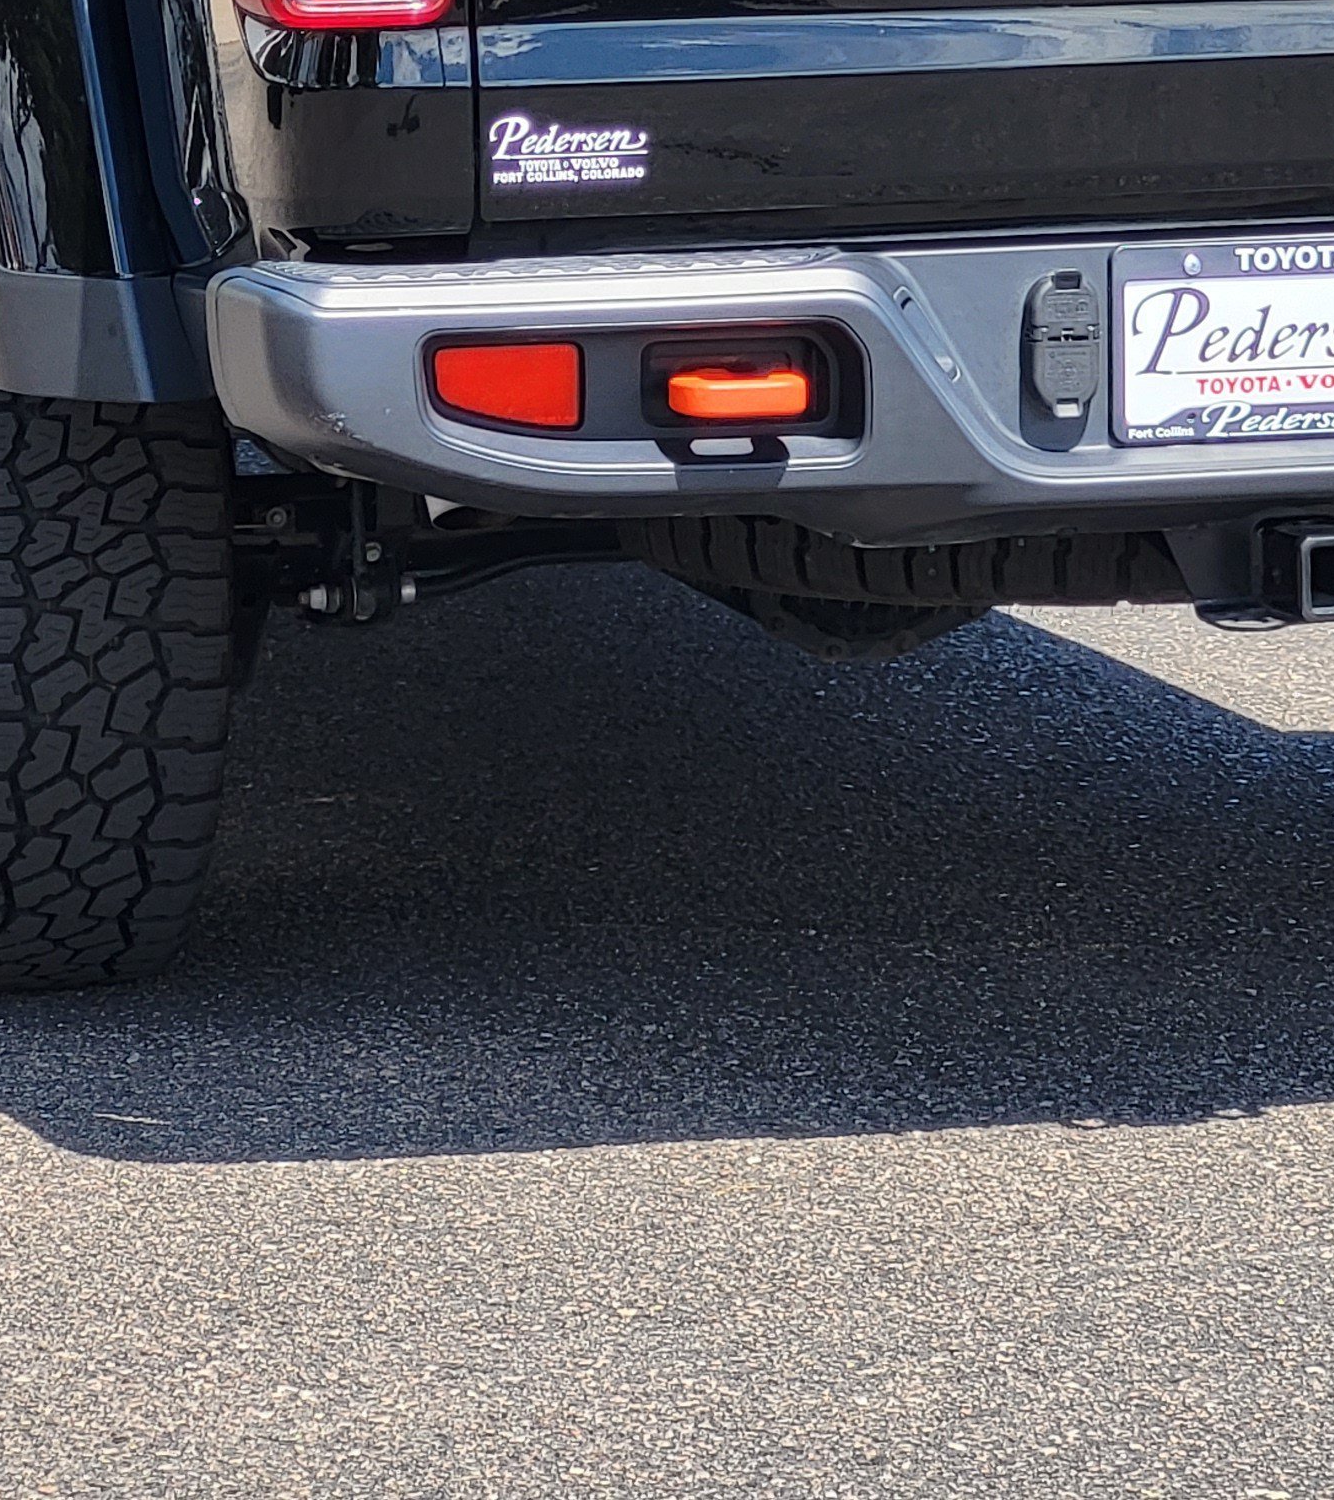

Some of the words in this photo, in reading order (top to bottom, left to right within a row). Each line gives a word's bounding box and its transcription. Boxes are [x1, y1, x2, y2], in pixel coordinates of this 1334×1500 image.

[489, 116, 648, 160] Pedersen
[519, 159, 561, 172] TOYOTA
[570, 157, 619, 169] VOLVO
[493, 171, 523, 184] FORT
[581, 167, 645, 180] COLORADO
[1197, 376, 1281, 395] TOYOTA
[1128, 428, 1153, 439] Fort
[1155, 426, 1195, 438] Collins
